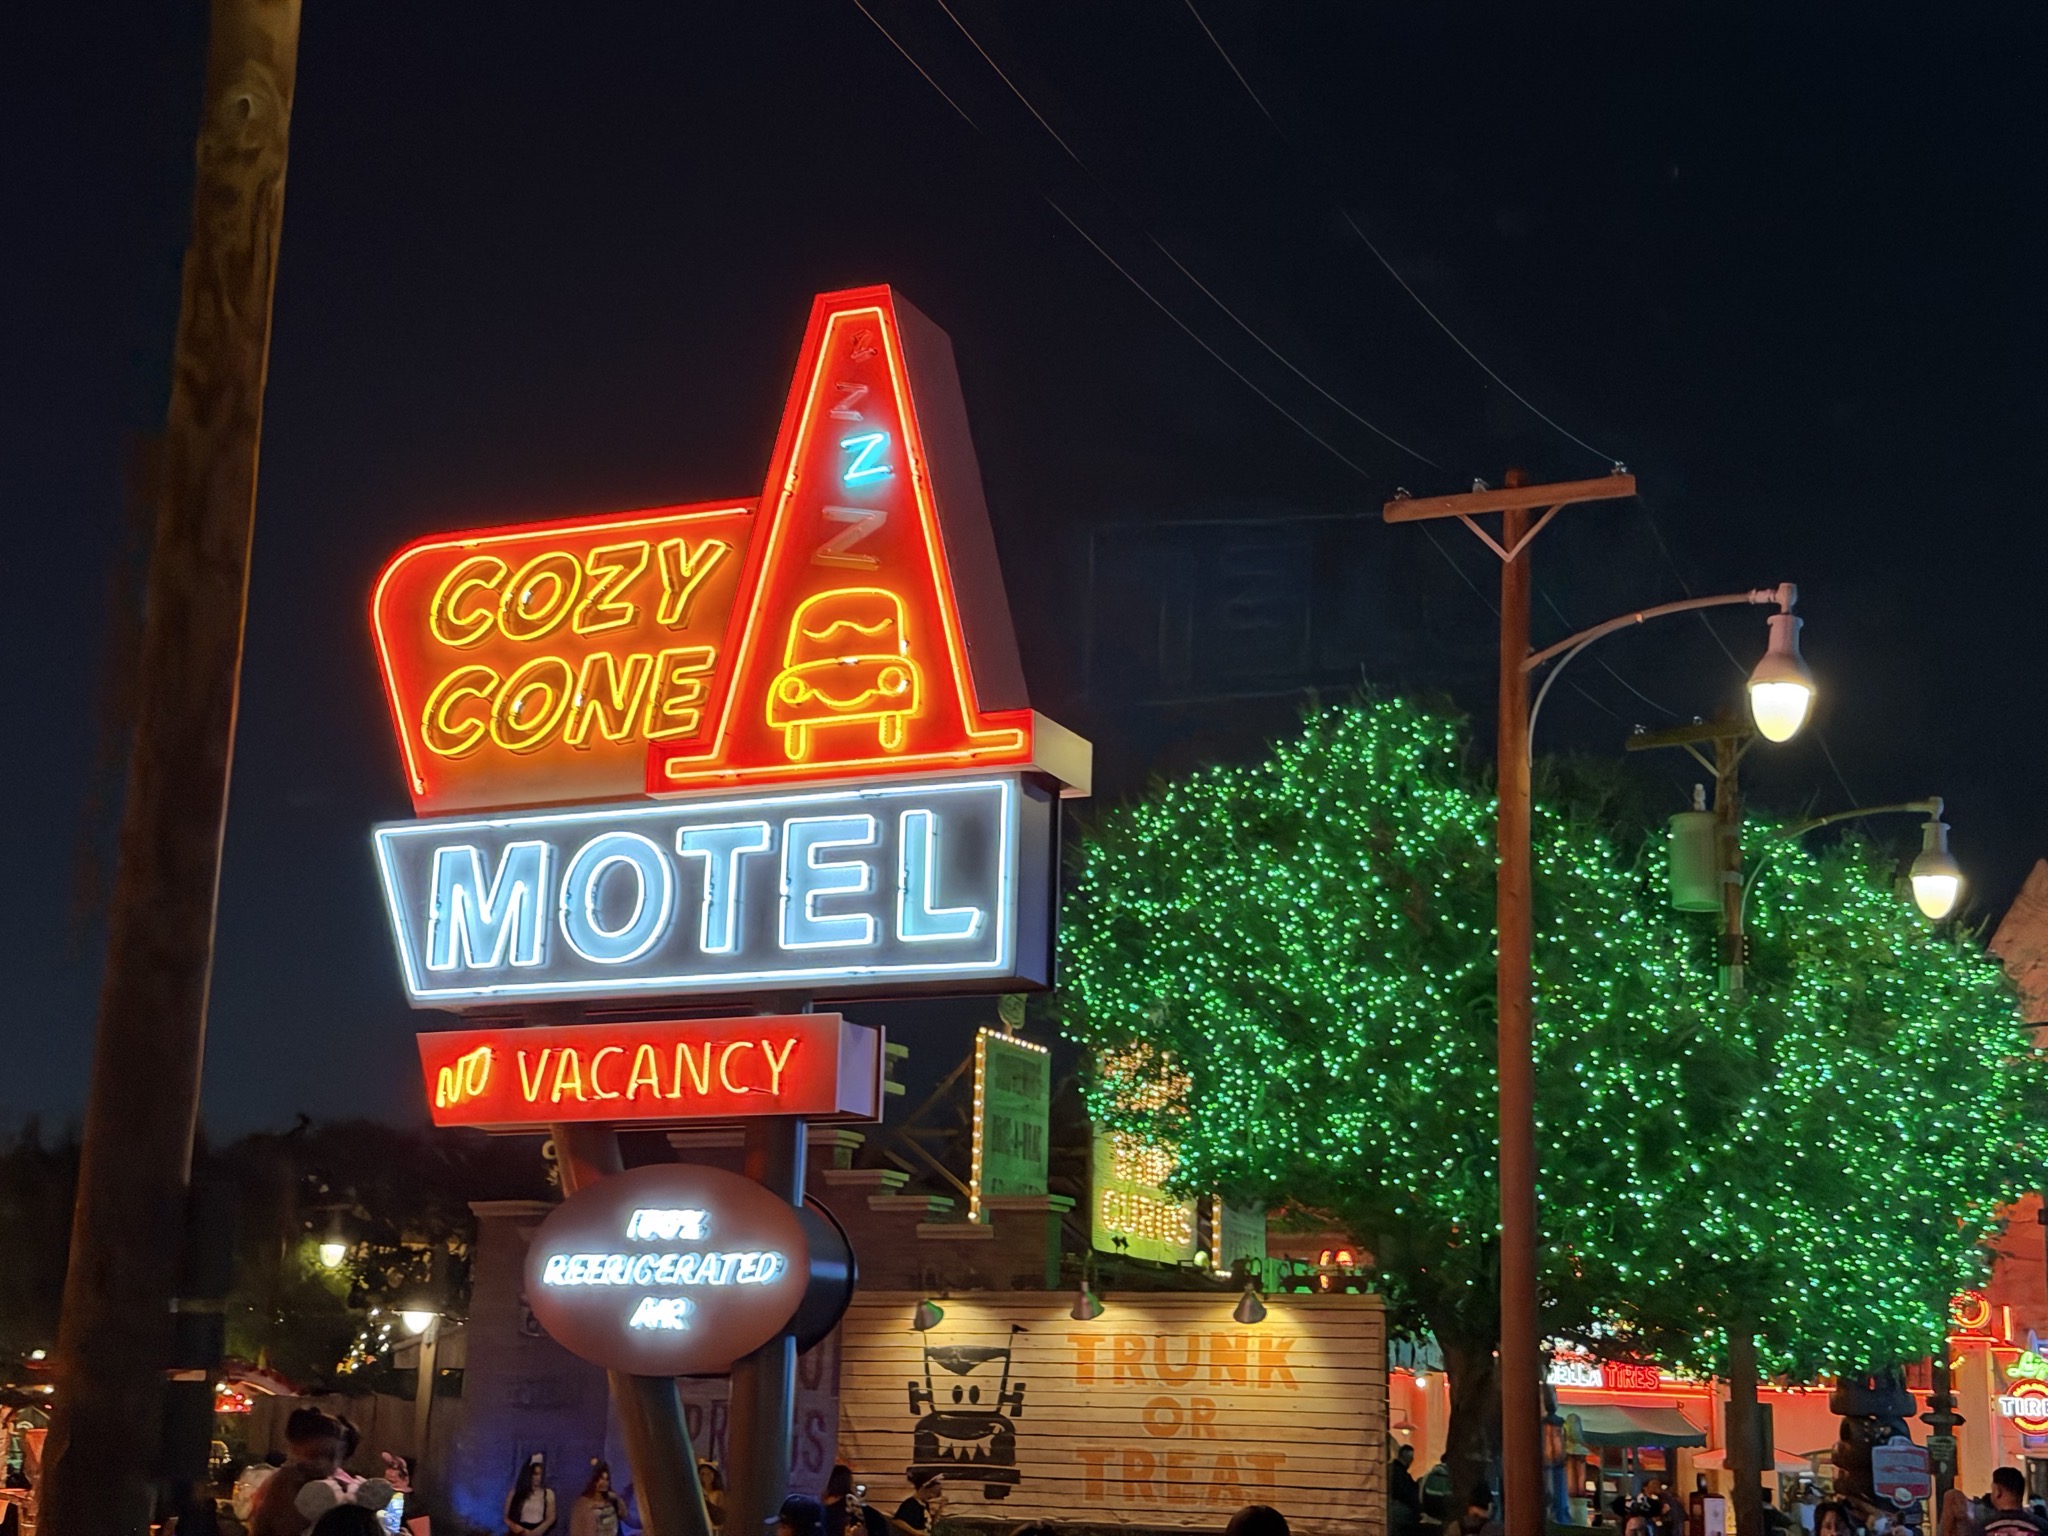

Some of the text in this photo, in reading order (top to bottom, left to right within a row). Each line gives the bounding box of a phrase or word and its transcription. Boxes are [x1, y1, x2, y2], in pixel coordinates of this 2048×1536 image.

[840, 432, 893, 486] Z
[811, 506, 887, 570] Z
[430, 537, 732, 648] COZY
[421, 646, 717, 757] CONE
[425, 809, 985, 970] MOTEL
[436, 1038, 797, 1108] NO VACANCY
[1067, 1331, 1300, 1391] TRUNK
[1605, 1361, 1660, 1390] TIRES
[1142, 1396, 1218, 1438] OR
[1076, 1447, 1286, 1506] TREAT
